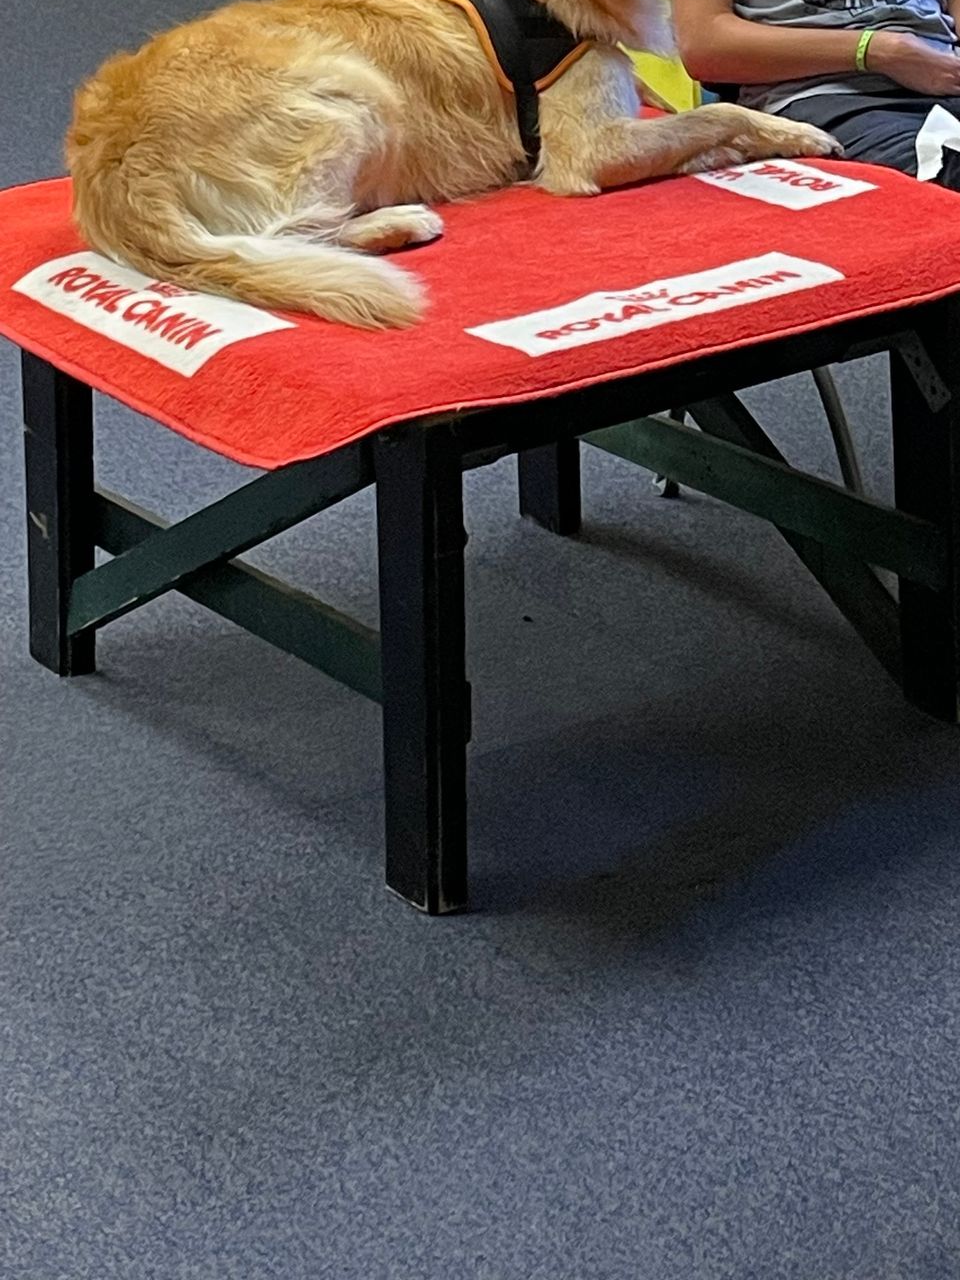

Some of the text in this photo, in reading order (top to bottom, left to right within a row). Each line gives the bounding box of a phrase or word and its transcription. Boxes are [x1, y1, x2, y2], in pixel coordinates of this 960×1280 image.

[48, 267, 223, 350] ROYAL CANIN
[535, 270, 801, 339] ROYAL CANIN
